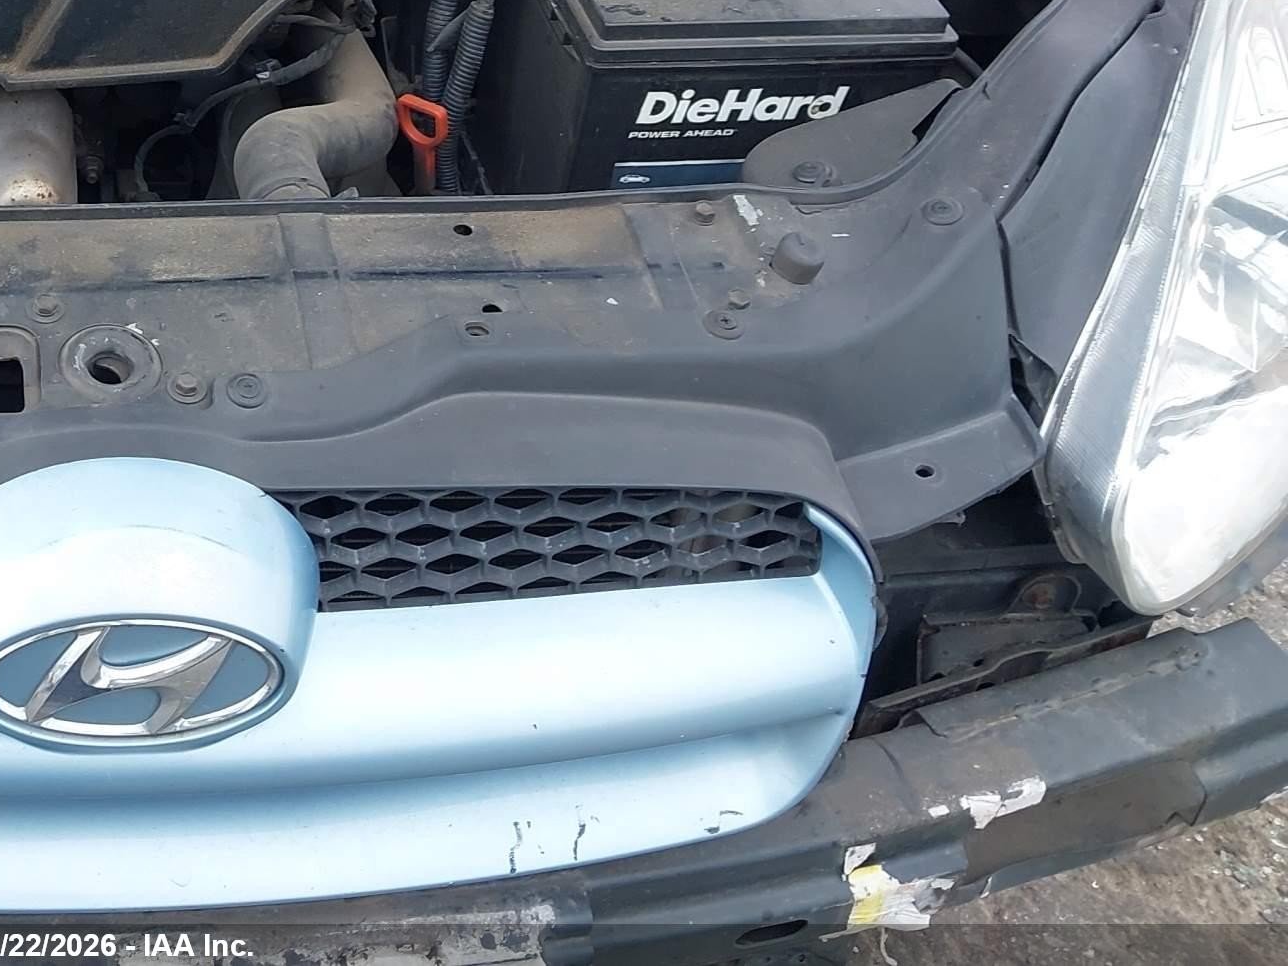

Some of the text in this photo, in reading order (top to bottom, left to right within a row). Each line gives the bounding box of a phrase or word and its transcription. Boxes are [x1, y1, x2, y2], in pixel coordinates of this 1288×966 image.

[635, 86, 851, 124] DieHard
[627, 128, 734, 140] POWER AHEAD
